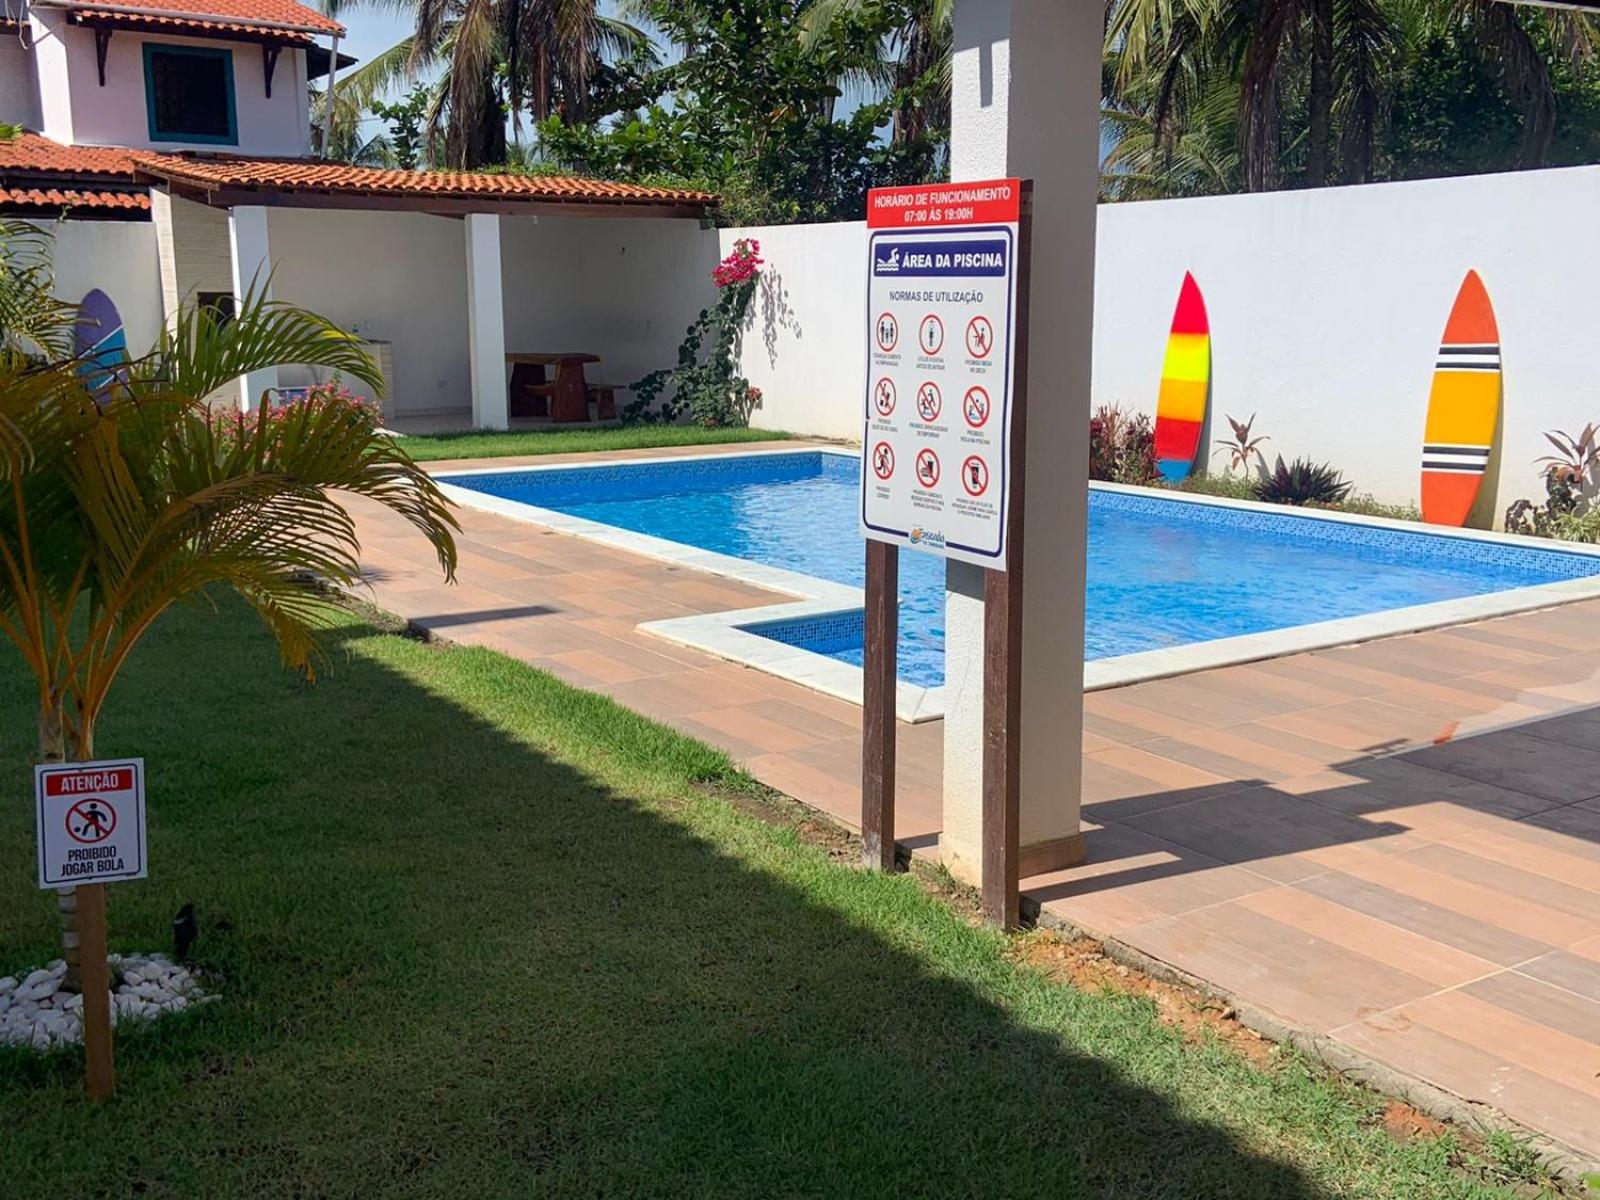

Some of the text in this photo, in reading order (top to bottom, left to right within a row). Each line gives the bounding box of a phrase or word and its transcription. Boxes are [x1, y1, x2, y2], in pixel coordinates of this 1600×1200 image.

[874, 186, 1011, 208] HORÁRIO DE FUNCIONAMENTO
[904, 210, 927, 222] 07:00
[944, 207, 974, 220] 19:00H
[902, 251, 1003, 268] ÁREA DA PISCINA
[889, 290, 984, 304] NORMAS DE UTILIZAÇÃO
[61, 772, 119, 792] ATENÇÃO
[68, 846, 117, 862] PROIBIDO
[61, 858, 124, 876] JOGAR BOLA
